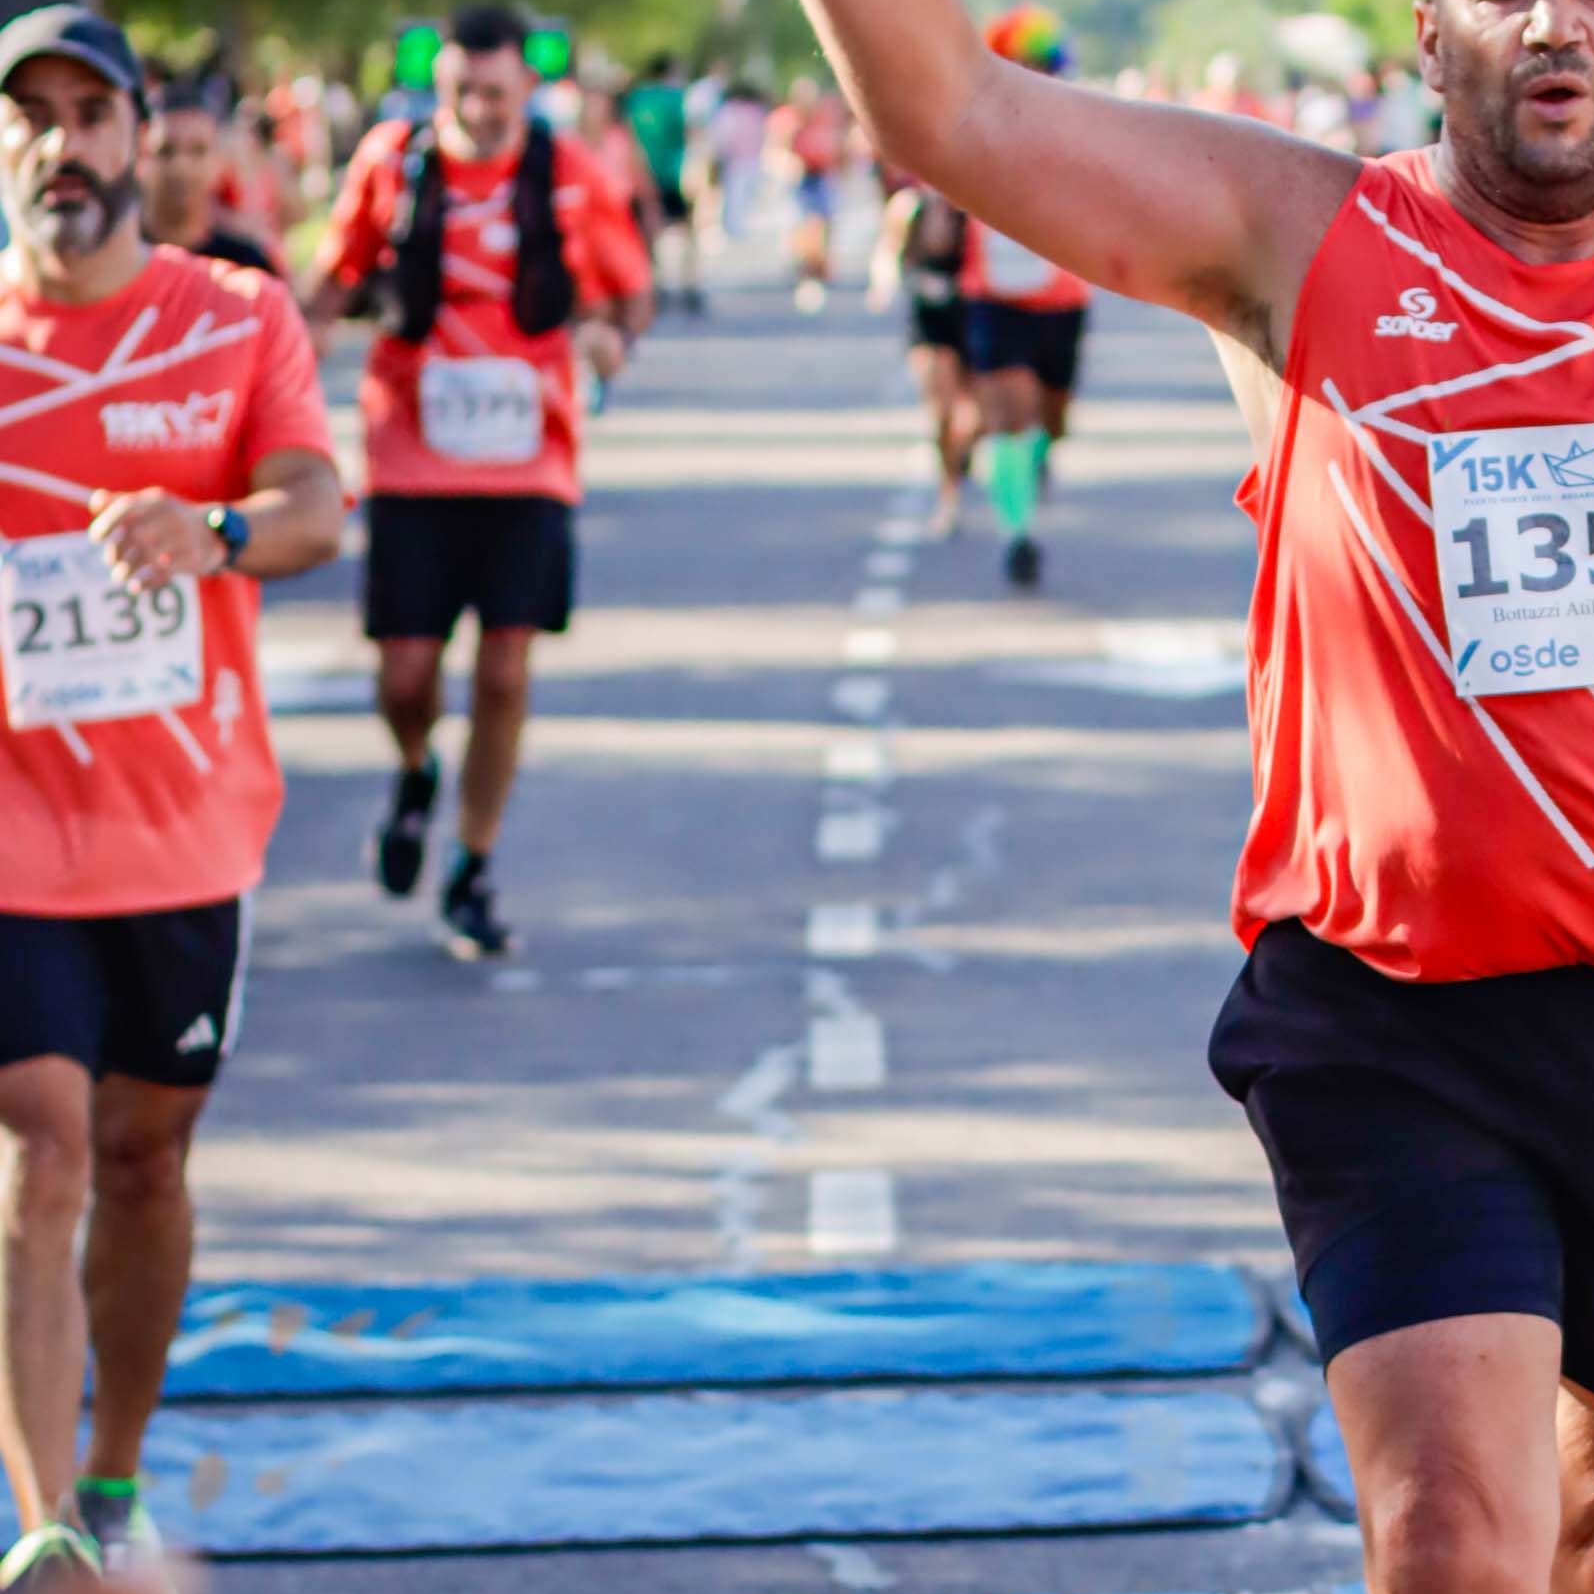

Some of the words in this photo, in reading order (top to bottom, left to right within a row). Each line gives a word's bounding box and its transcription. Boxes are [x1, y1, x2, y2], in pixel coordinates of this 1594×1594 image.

[1460, 454, 1538, 493] 15K
[12, 582, 188, 654] 2139
[1492, 605, 1560, 624] Bottazzi
[1490, 638, 1581, 674] osde
